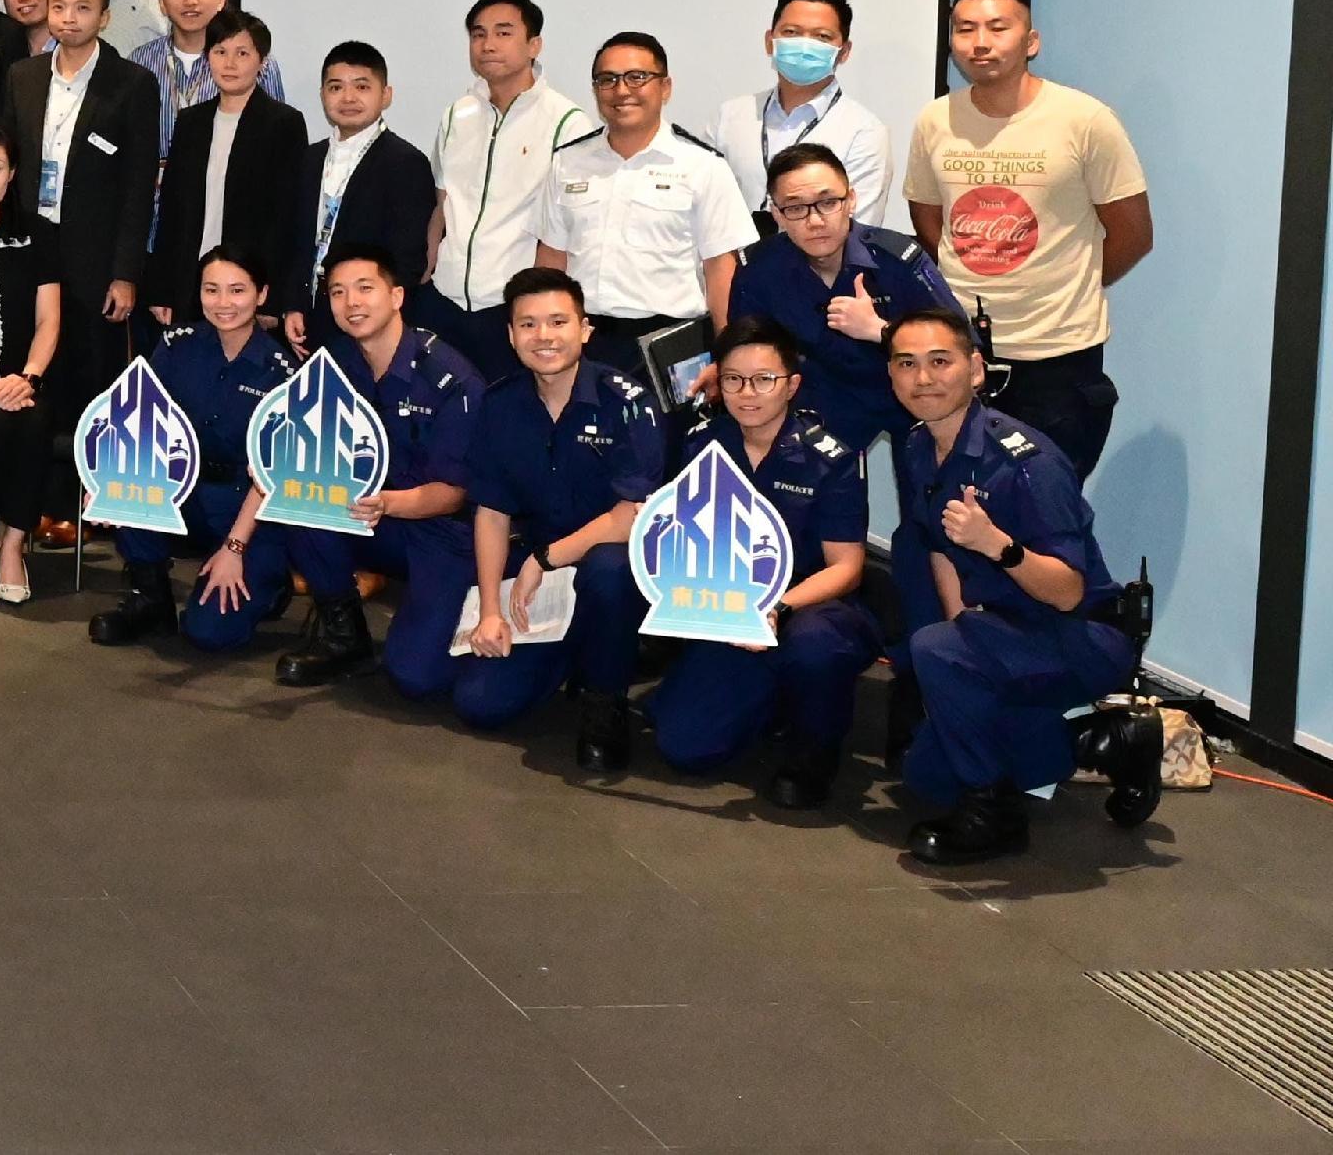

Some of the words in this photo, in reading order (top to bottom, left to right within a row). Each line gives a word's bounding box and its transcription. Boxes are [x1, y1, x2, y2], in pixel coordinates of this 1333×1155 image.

[943, 159, 985, 172] GOOD
[993, 160, 1045, 173] THINGS
[966, 173, 986, 184] TO
[993, 173, 1019, 185] EAT
[979, 200, 1007, 209] Drink
[780, 482, 809, 494] POLICE
